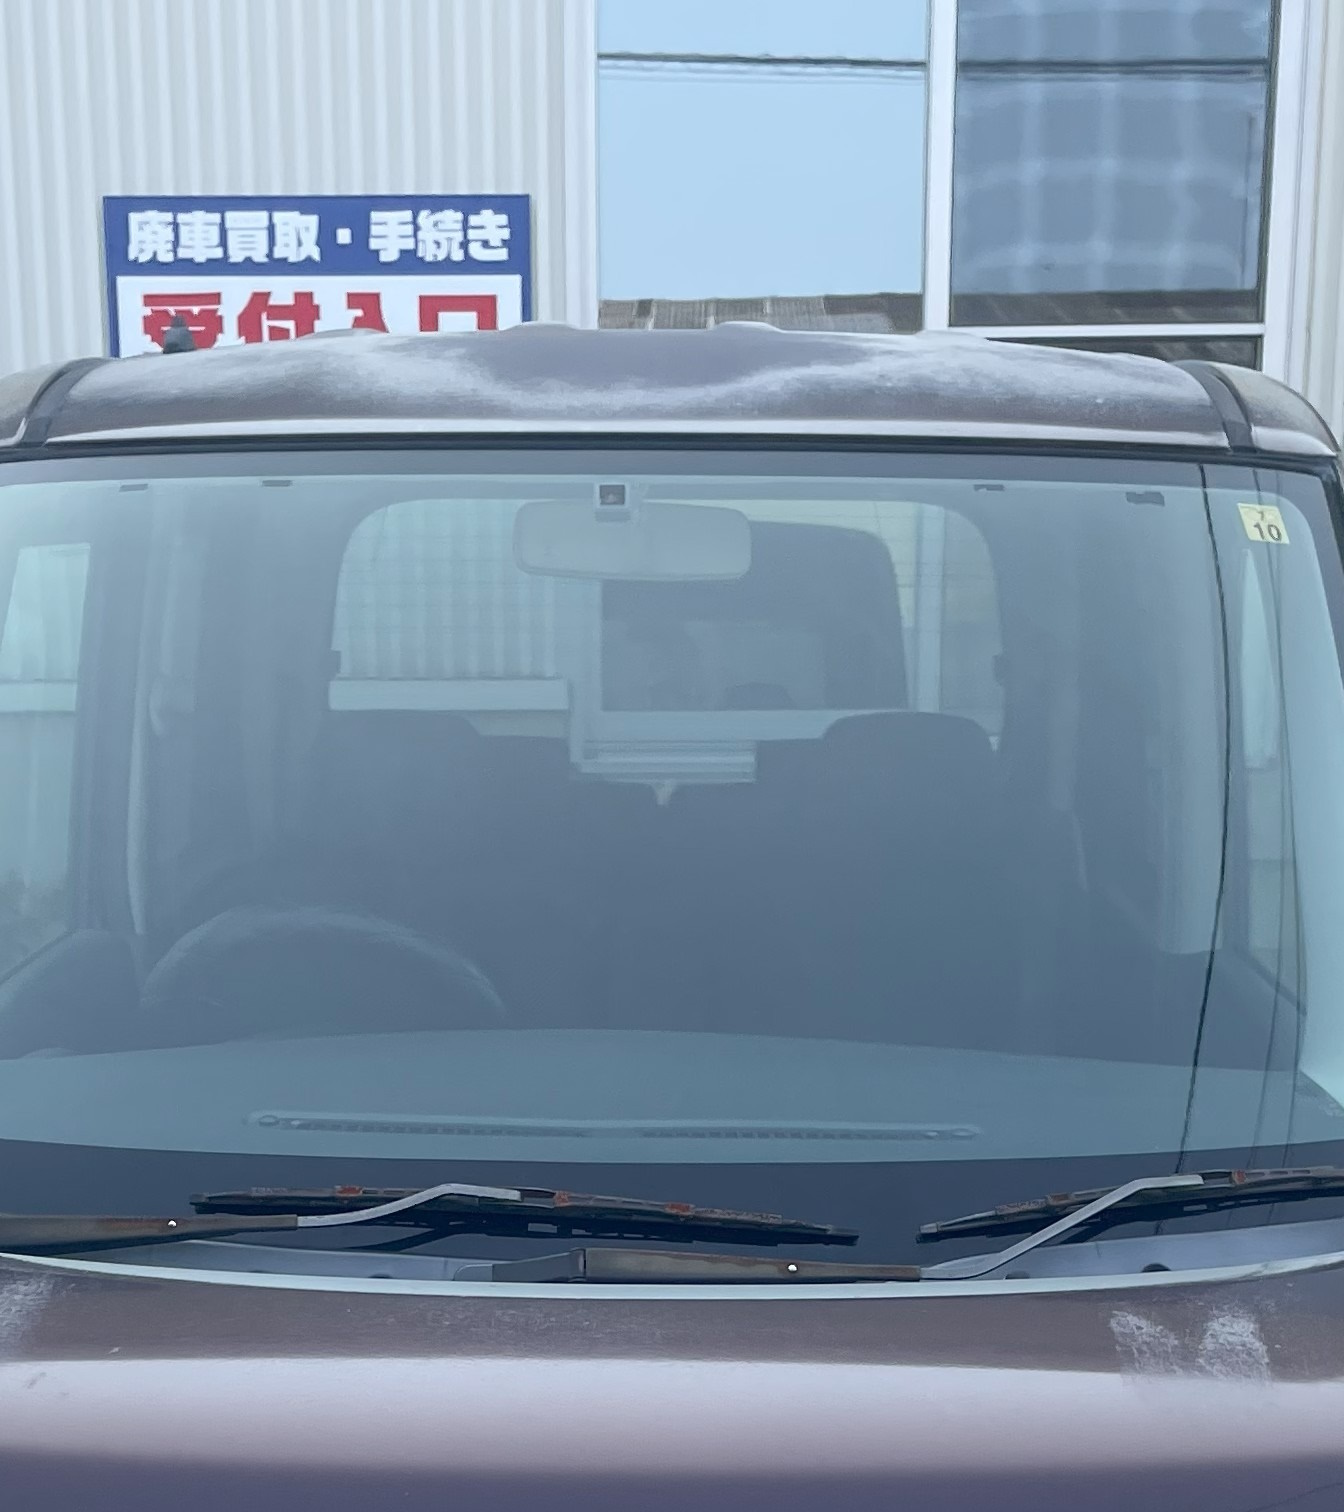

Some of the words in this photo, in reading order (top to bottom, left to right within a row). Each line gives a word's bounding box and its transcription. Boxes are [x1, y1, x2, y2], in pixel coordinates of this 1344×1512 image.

[128, 210, 510, 264] 廃車買取・手続き
[1253, 522, 1282, 541] 10
